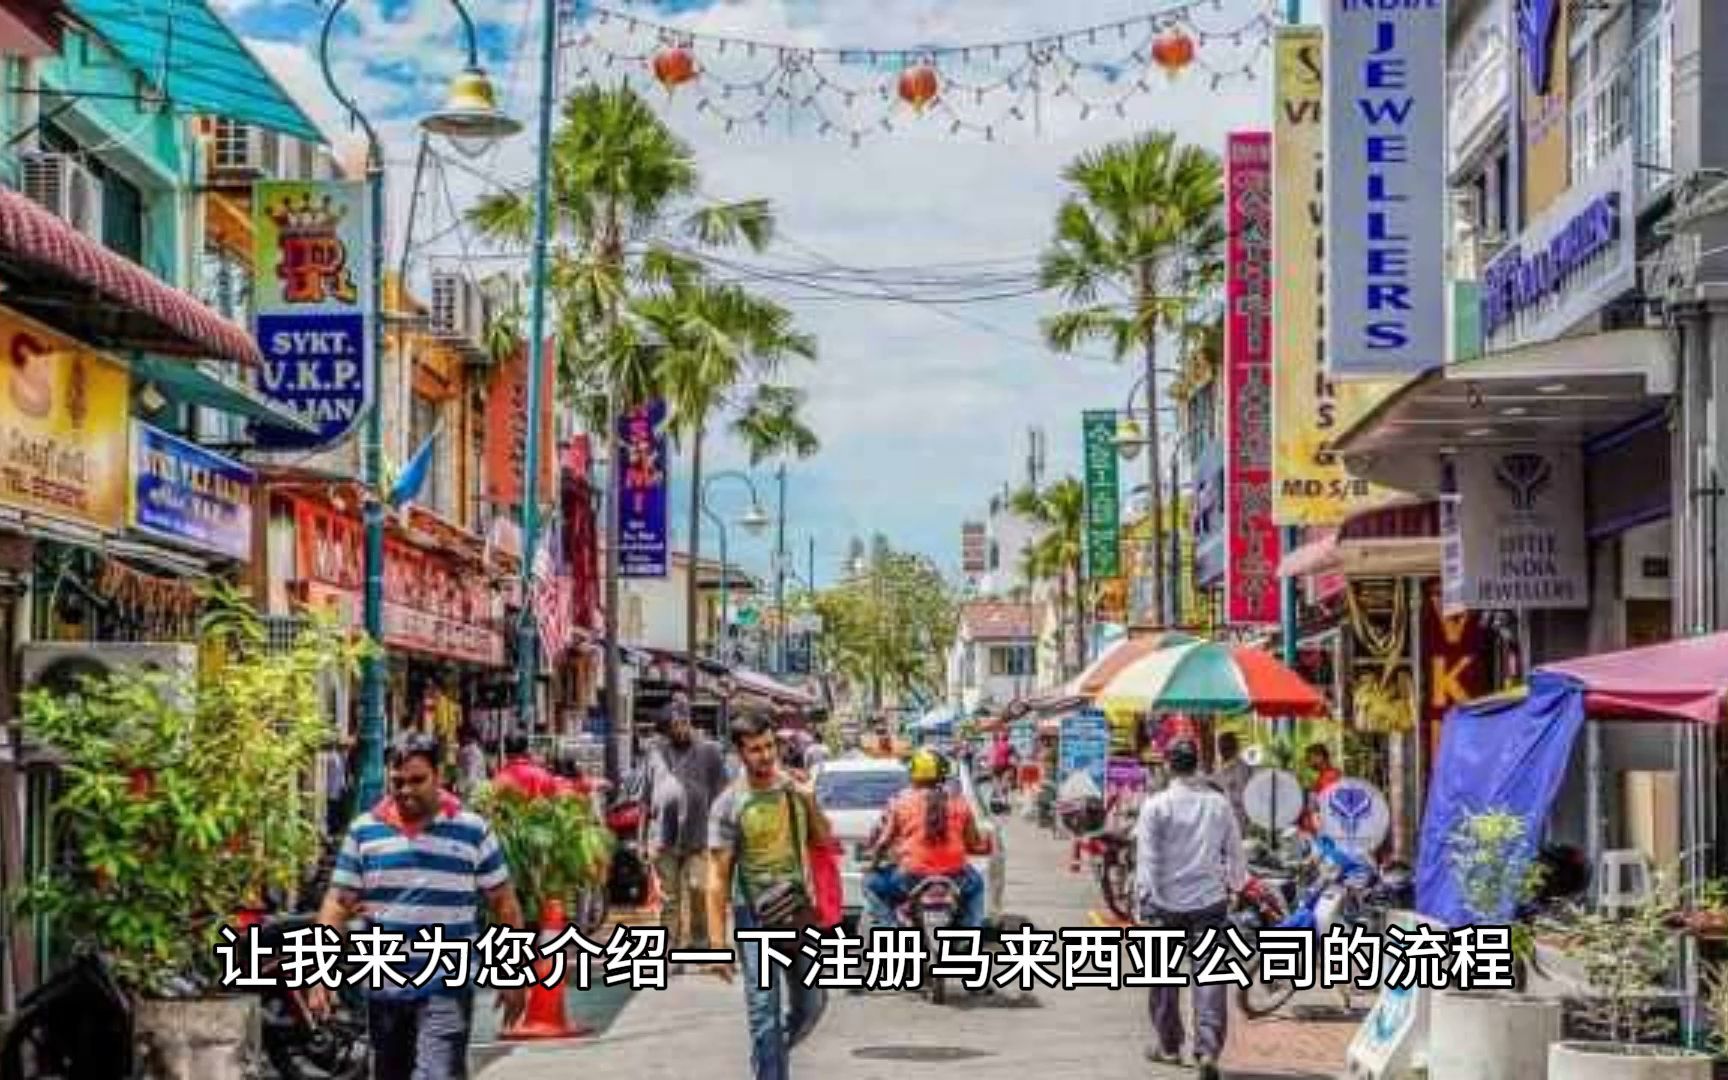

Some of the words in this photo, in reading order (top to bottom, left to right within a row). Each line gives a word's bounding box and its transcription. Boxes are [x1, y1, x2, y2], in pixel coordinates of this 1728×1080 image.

[1359, 22, 1415, 349] JEWELLERS
[272, 331, 355, 354] SYKT.
[263, 359, 361, 391] V.K.P.
